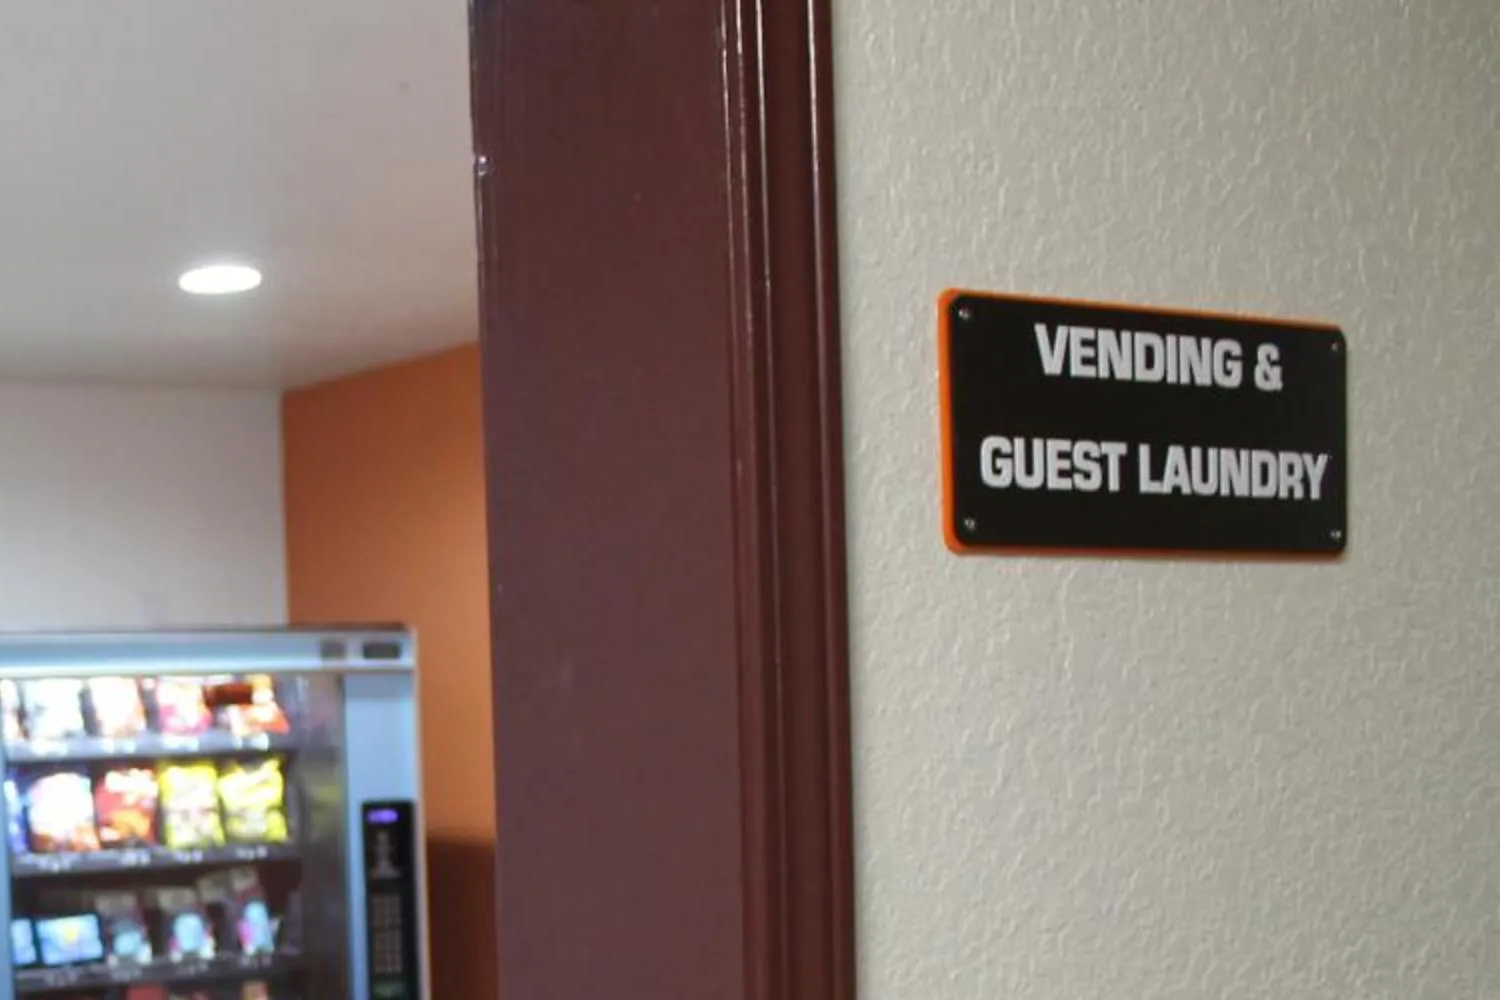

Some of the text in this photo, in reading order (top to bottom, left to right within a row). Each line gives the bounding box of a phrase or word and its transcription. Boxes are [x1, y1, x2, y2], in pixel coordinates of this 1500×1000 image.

[1034, 323, 1283, 391] VENDING &
[979, 435, 1328, 500] GUEST LAUNDRY
